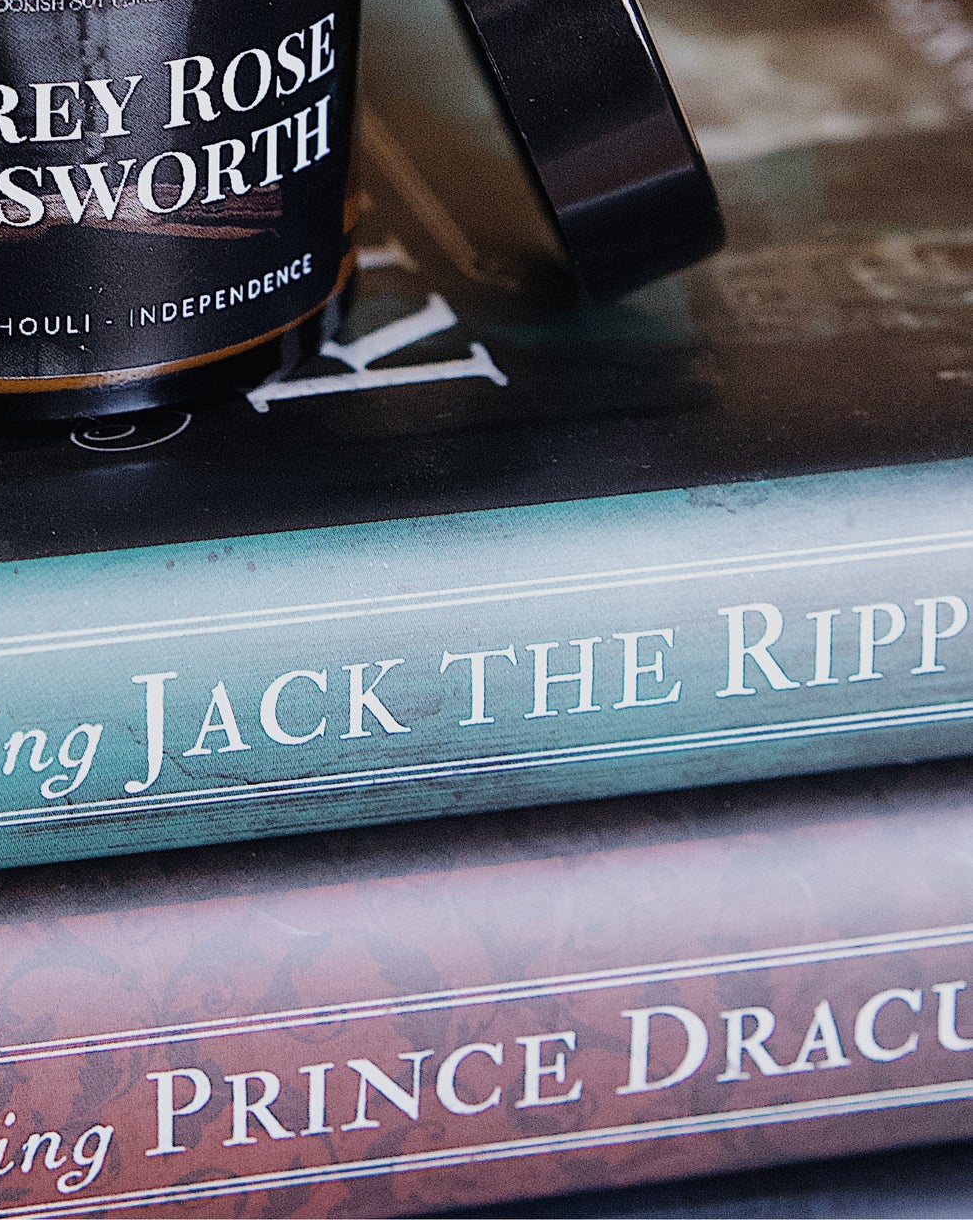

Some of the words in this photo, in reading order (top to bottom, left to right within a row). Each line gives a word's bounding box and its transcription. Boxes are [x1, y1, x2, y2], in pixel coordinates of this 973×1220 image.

[162, 12, 337, 130] ROSE
[128, 252, 313, 329] INDEPENDENCE
[124, 658, 411, 794] JACK
[439, 627, 683, 728] THE
[715, 595, 970, 699] RIPP
[144, 1030, 584, 1158] PRINCE
